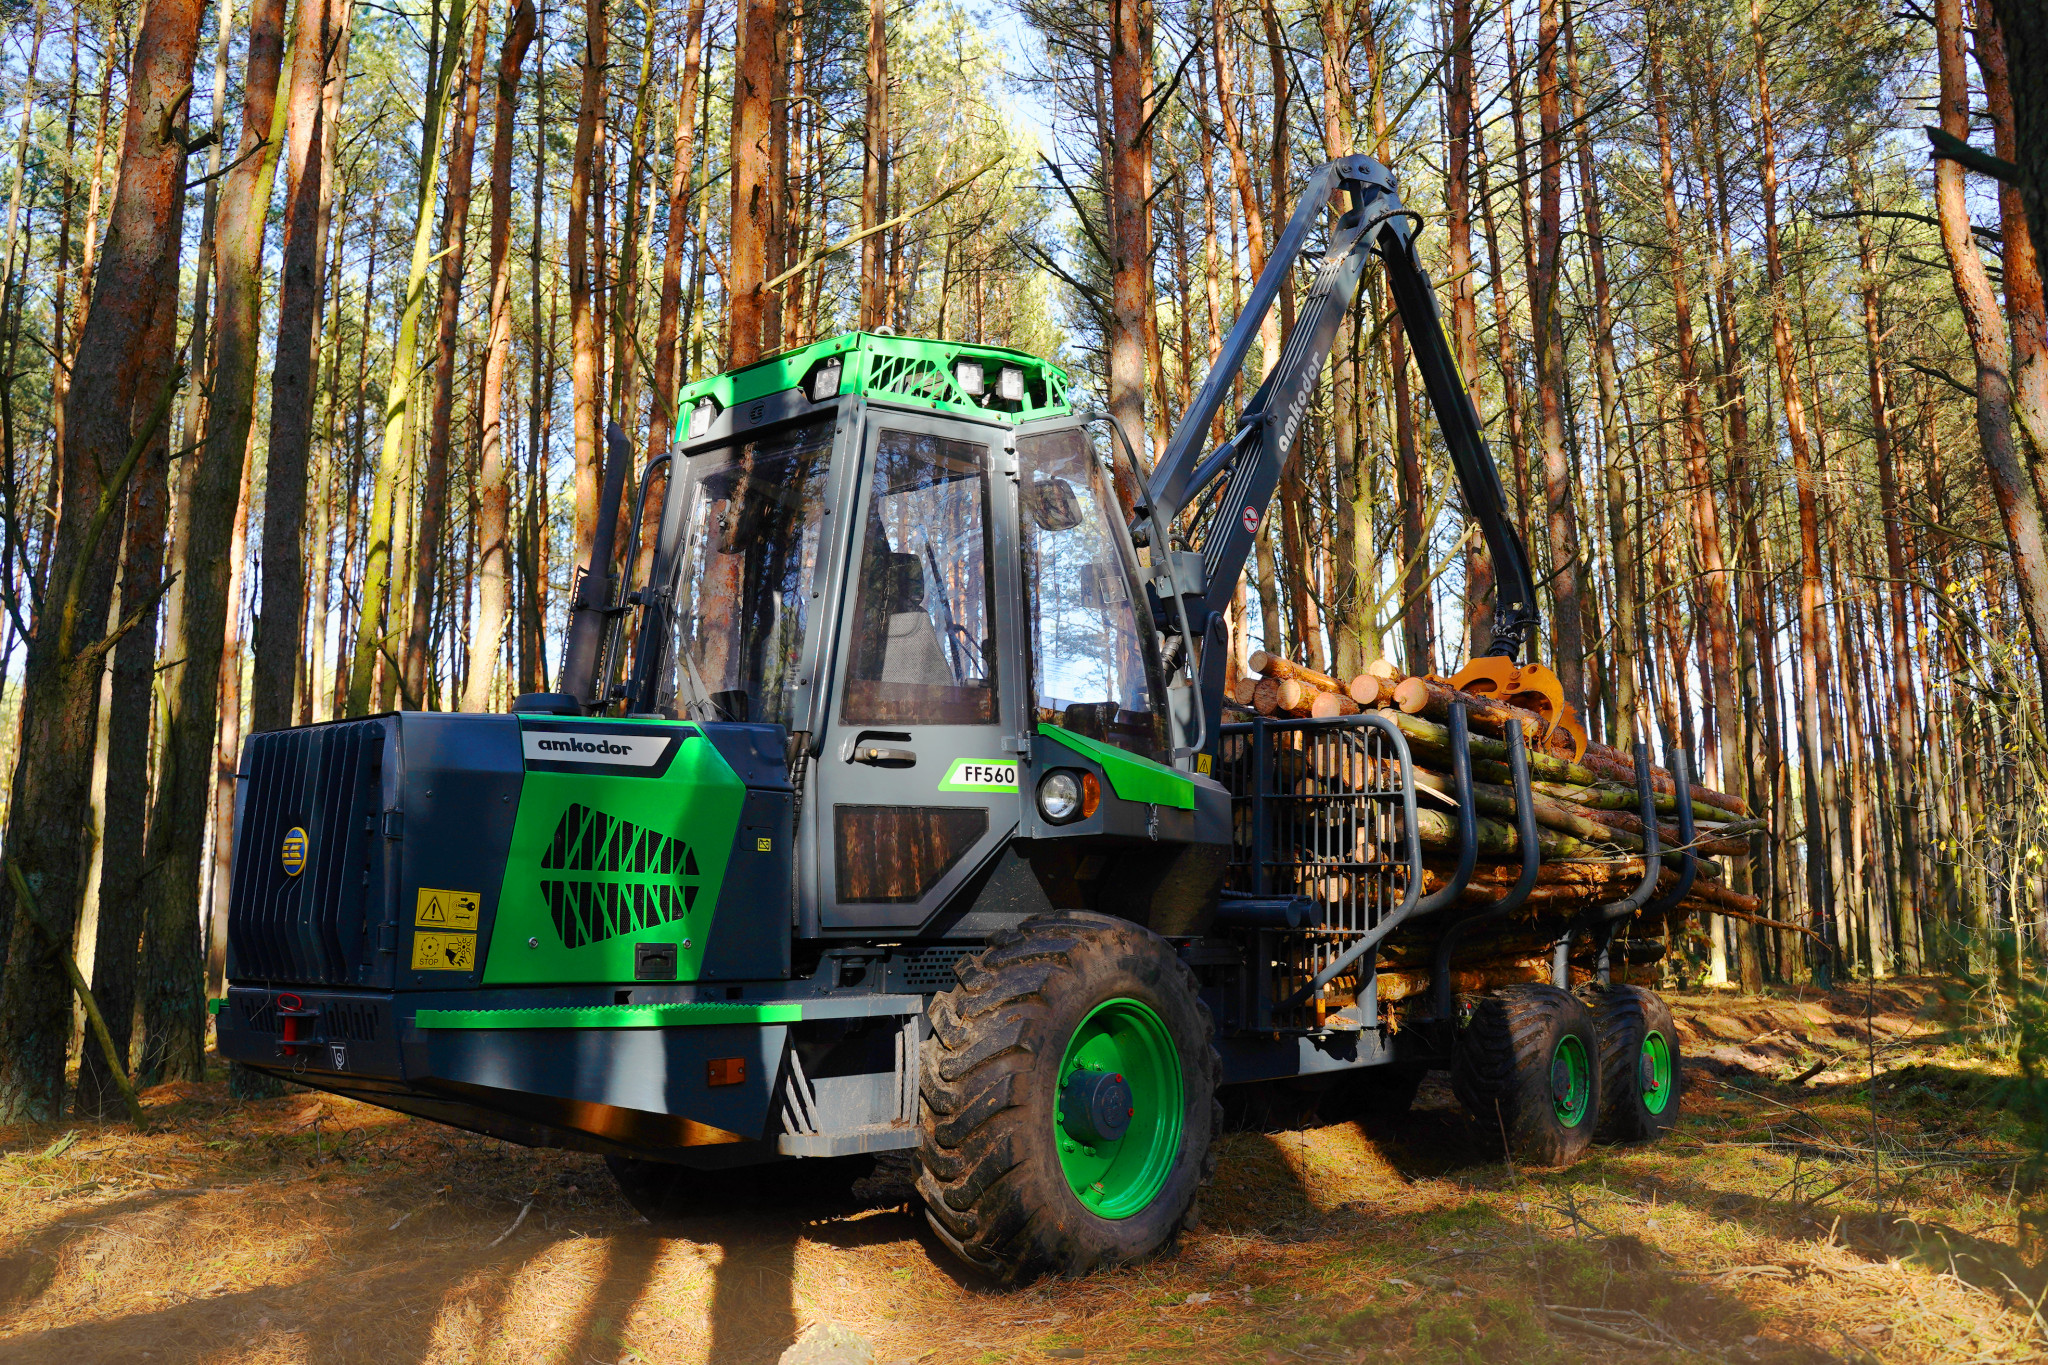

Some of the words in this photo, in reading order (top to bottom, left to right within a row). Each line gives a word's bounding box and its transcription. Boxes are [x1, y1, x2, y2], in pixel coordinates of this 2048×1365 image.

[1279, 351, 1321, 453] amkodor
[538, 737, 632, 756] amkodor
[965, 766, 1015, 783] FF560
[419, 958, 438, 966] STOP
